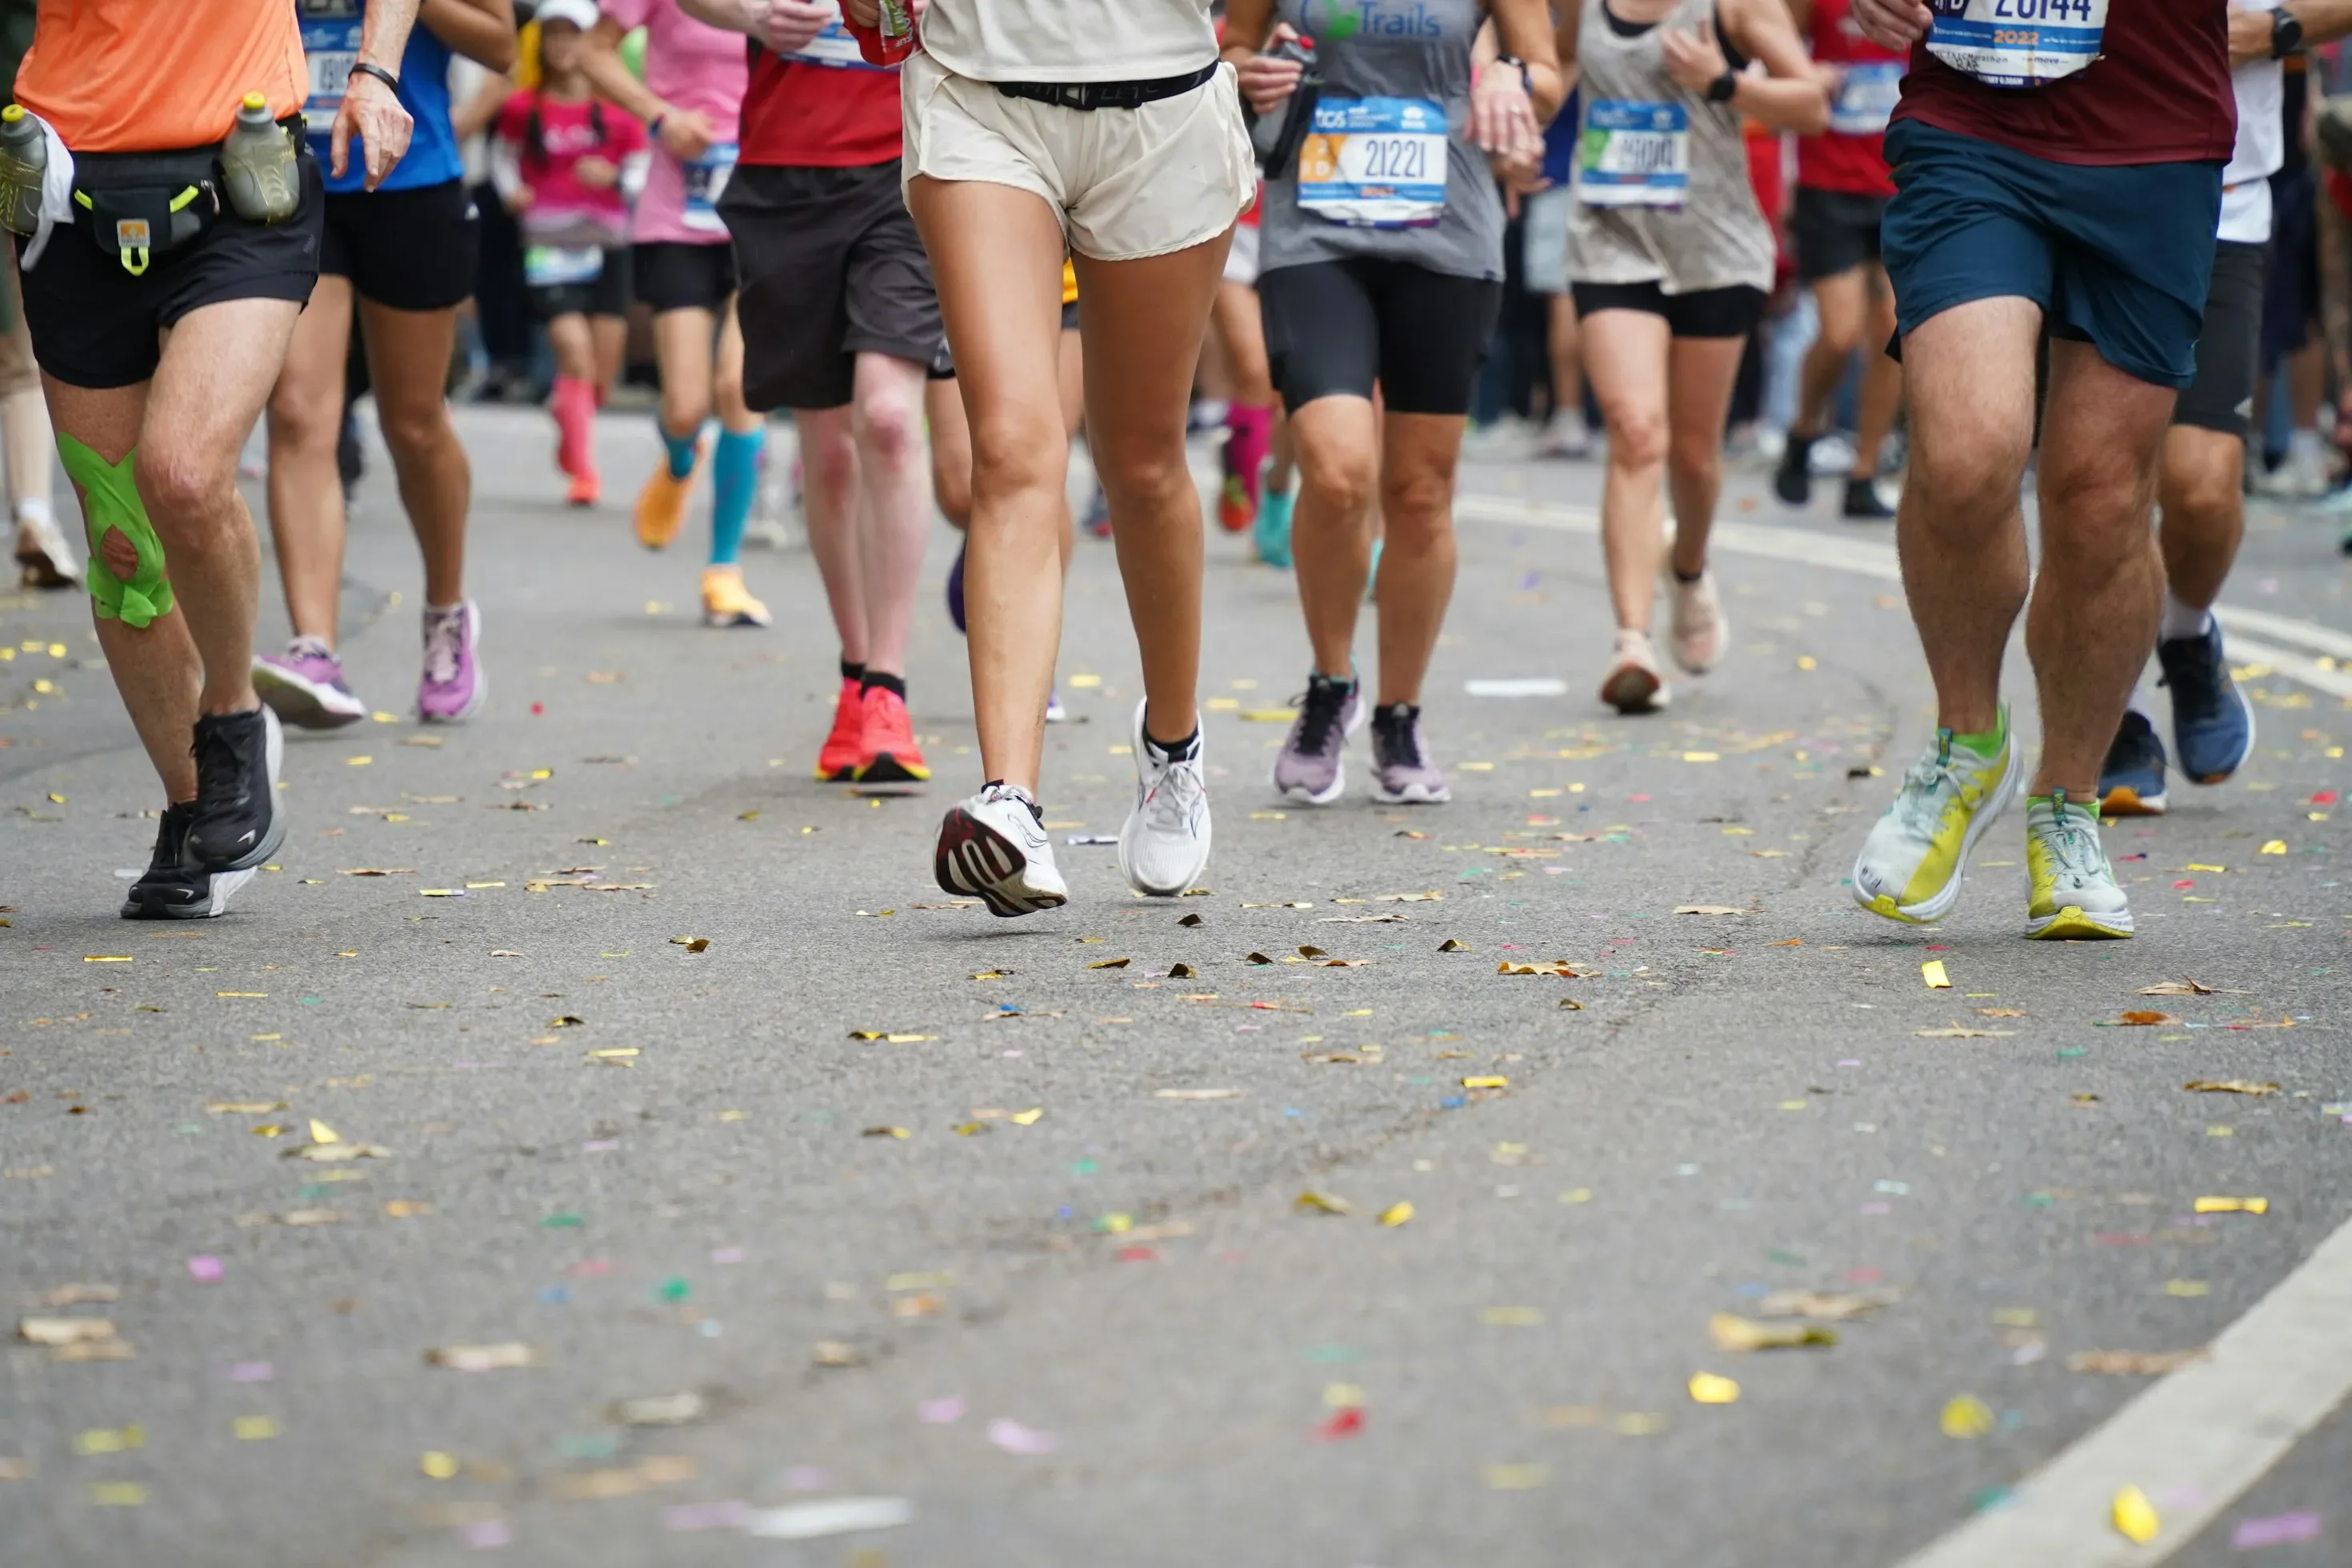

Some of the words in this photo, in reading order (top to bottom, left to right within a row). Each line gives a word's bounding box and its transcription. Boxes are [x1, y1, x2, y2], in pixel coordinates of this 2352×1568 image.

[1357, 1, 1443, 35] Trails
[1993, 30, 2039, 46] 2022
[1315, 108, 1346, 128] tcs
[1365, 139, 1426, 178] 21221
